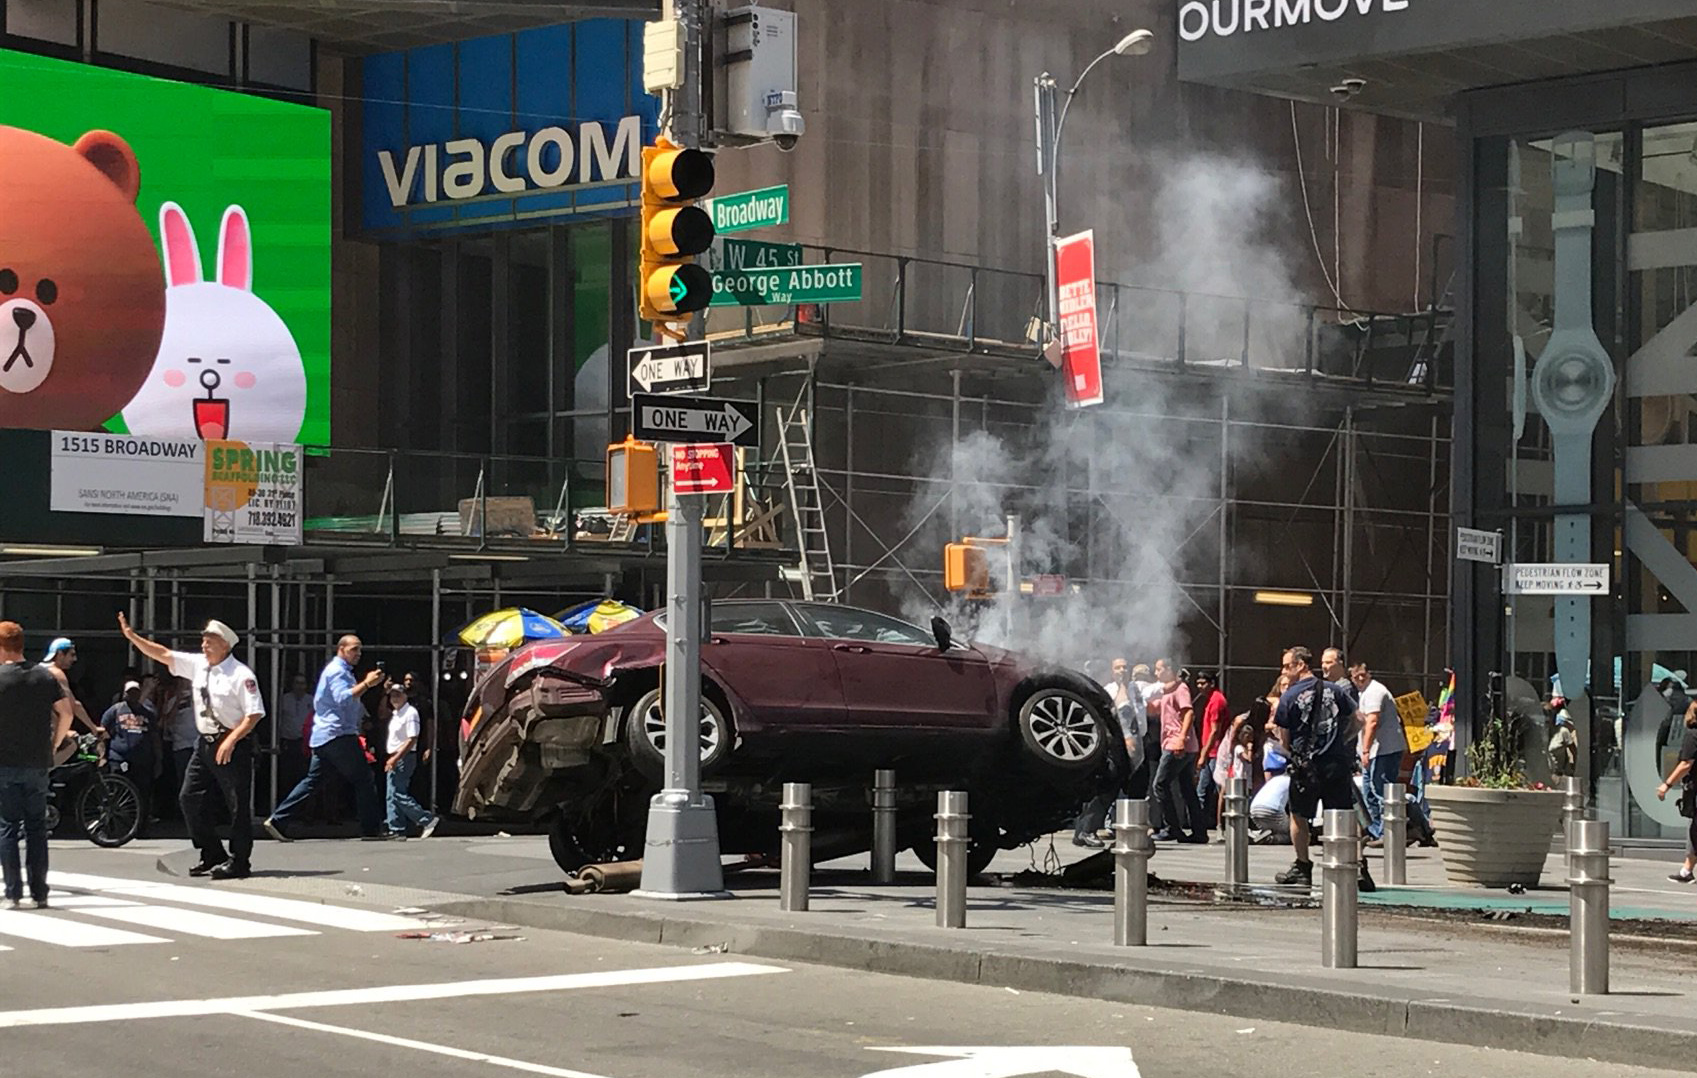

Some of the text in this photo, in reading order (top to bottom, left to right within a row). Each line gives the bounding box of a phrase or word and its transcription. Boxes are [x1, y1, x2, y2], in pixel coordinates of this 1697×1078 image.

[1179, 0, 1410, 41] OURMO
[717, 195, 784, 229] Broadway
[728, 243, 799, 270] W 45 St
[712, 268, 852, 296] George Abbott
[771, 292, 793, 304] Way
[640, 358, 698, 382] ONE WAY
[652, 409, 741, 432] ONE WAY
[61, 436, 197, 458] 1515 BROADWAY
[675, 450, 686, 460] NO
[212, 447, 297, 474] SPRING
[100, 490, 126, 500] NORTH
[127, 490, 158, 501] AMERICA
[1515, 568, 1604, 578] PEDESTRIAN FLOW ZONE
[1535, 579, 1565, 590] MOVING
